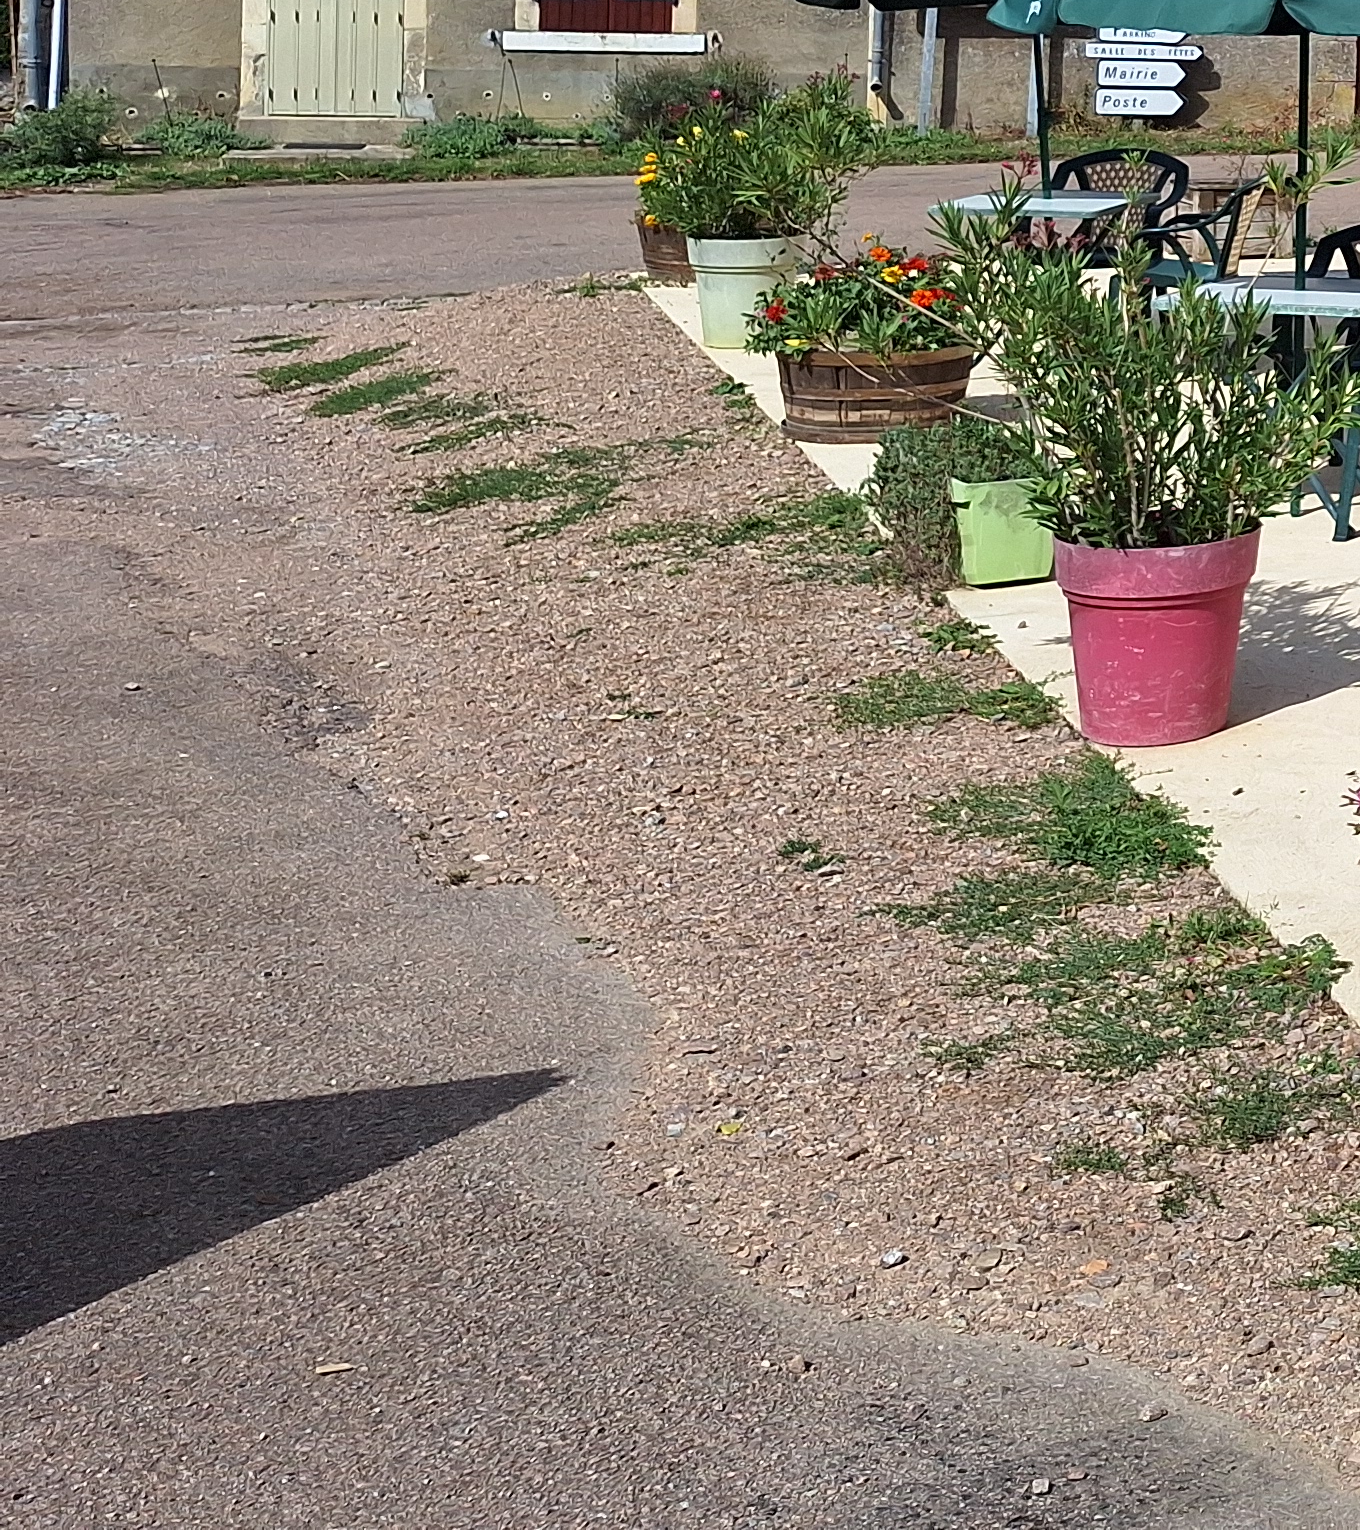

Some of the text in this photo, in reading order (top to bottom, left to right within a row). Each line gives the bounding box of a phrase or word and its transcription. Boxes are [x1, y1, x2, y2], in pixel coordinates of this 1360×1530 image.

[1093, 47, 1125, 56] SALLE
[1137, 48, 1156, 57] DES
[1104, 66, 1158, 80] Mairie
[1102, 95, 1148, 109] Poste
